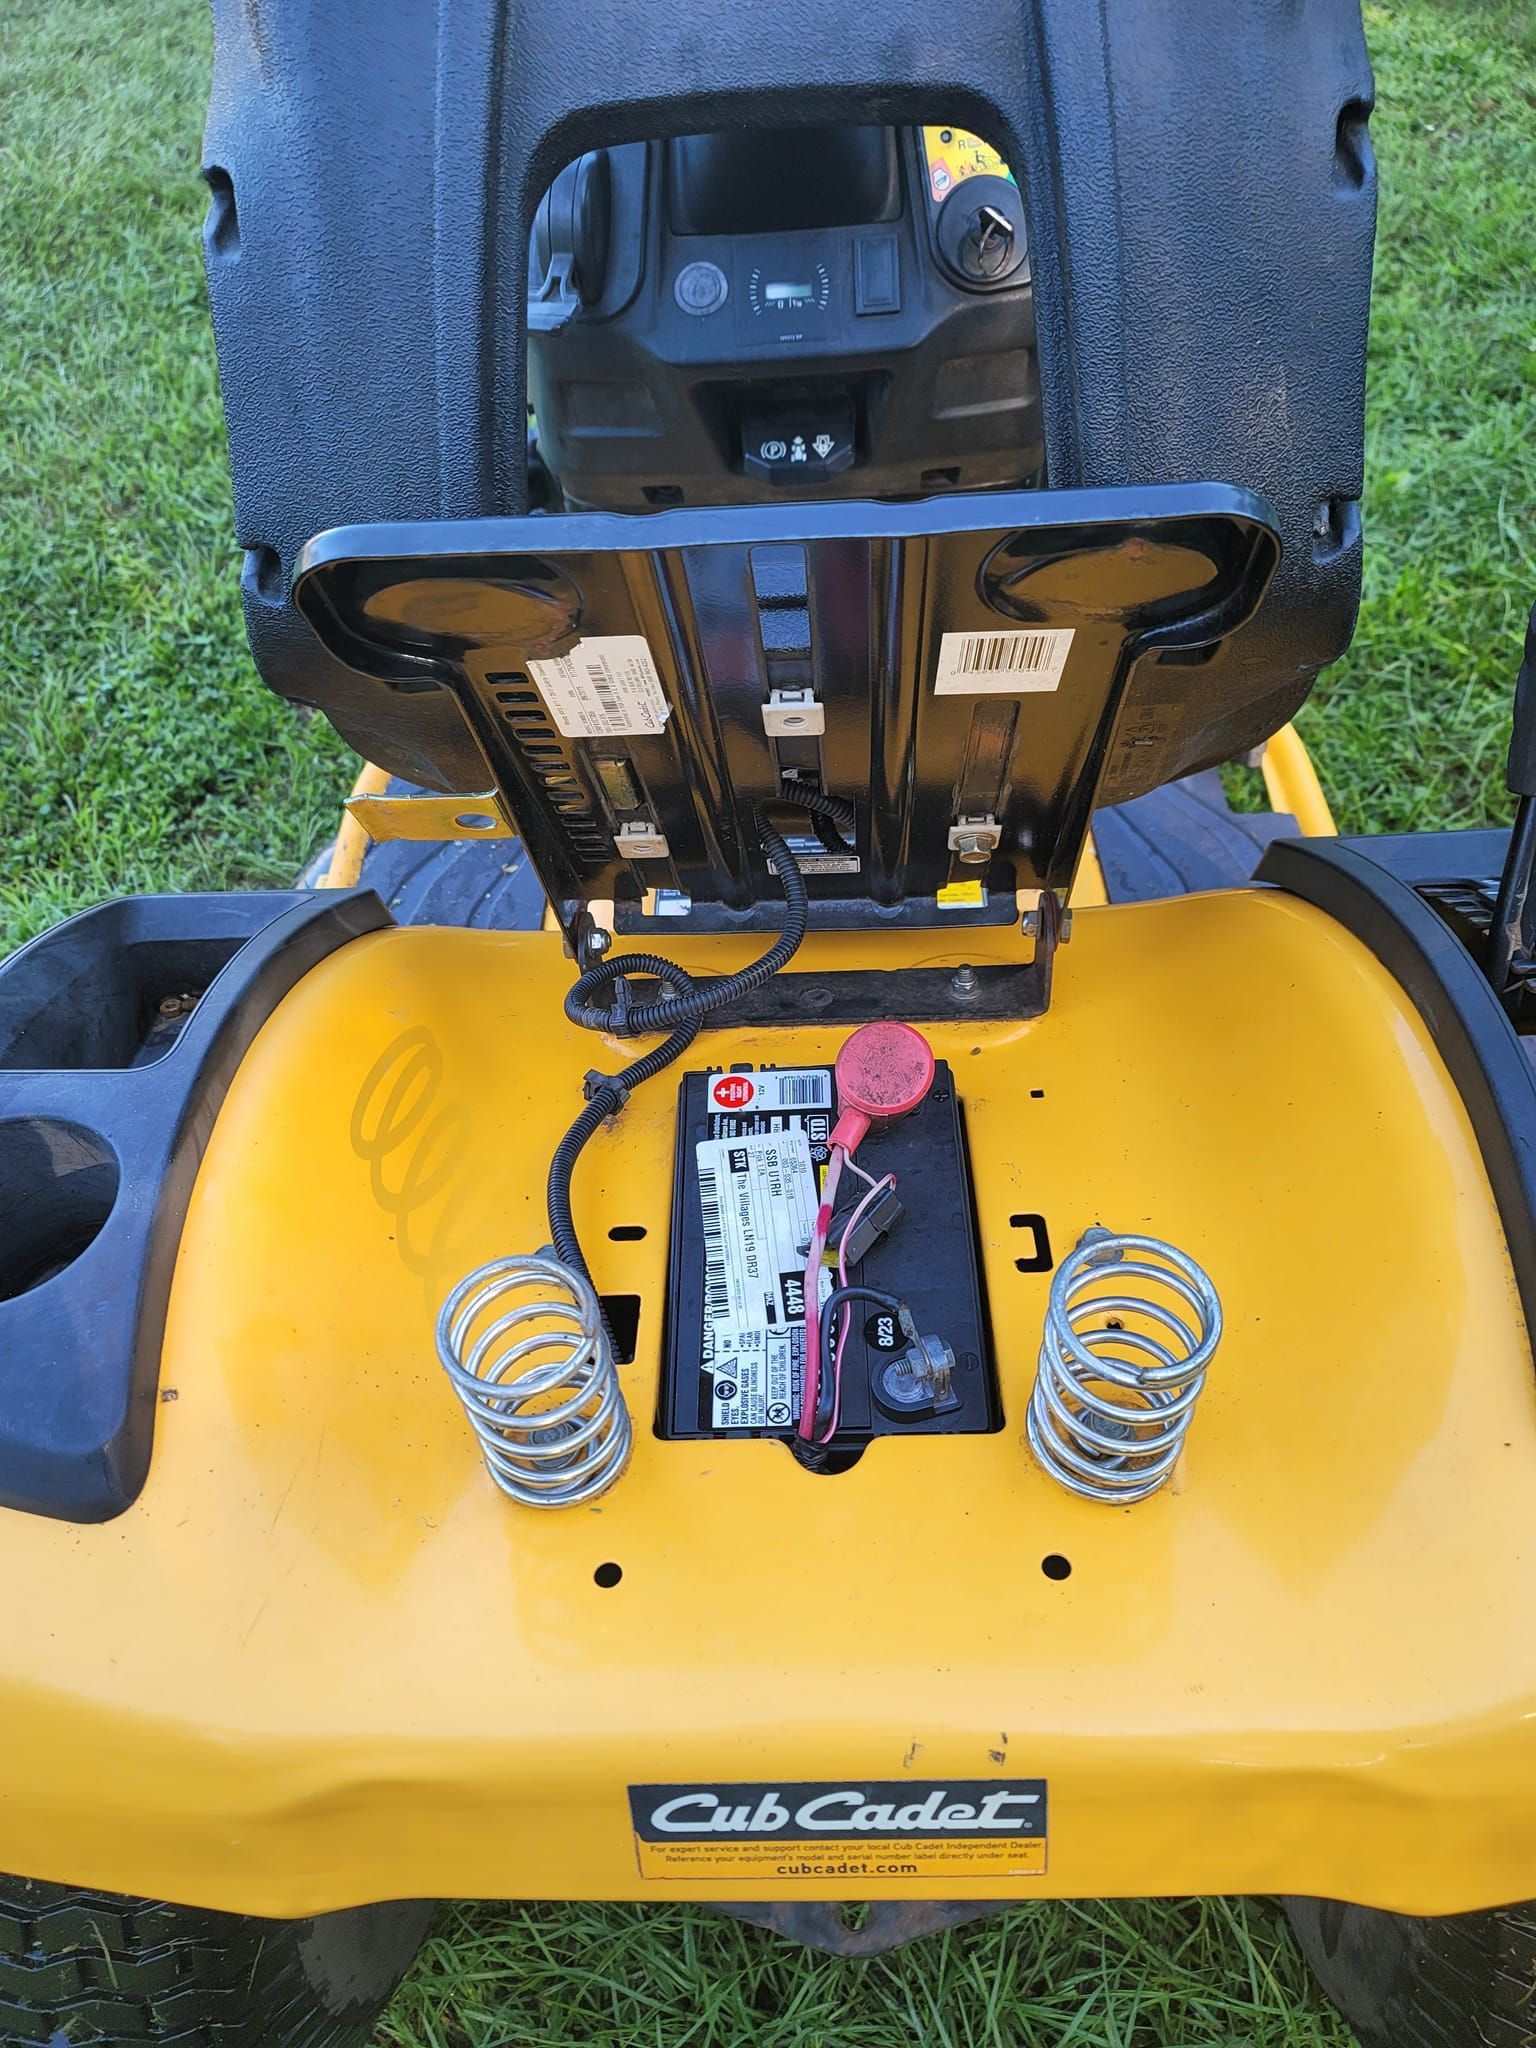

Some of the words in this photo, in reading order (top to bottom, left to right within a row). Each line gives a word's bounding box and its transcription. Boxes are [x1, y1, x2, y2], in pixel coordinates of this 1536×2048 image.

[811, 1118, 827, 1141] STD
[733, 1151, 747, 1169] STK
[765, 1149, 778, 1167] SSB
[736, 1174, 747, 1190] The
[768, 1170, 782, 1197] U1RH
[738, 1192, 751, 1227] Villages
[743, 1229, 756, 1252] LN19
[746, 1255, 759, 1279] DR37
[784, 1280, 805, 1314] 4448
[792, 1328, 800, 1356] EXPLOSION
[878, 1317, 894, 1347] 8/23
[723, 1340, 732, 1349] NO
[771, 1363, 778, 1371] OF
[778, 1344, 786, 1373] CHILDREN.
[741, 1368, 749, 1388] GASES
[750, 1362, 758, 1392] BLINDNESS
[792, 1380, 800, 1392] RISK
[778, 1382, 786, 1399] REACH
[740, 1390, 749, 1424] EXPLOSIVE
[750, 1393, 758, 1411] CAUSE
[758, 1392, 766, 1414] INJURY.
[792, 1394, 800, 1420] WARNING:
[721, 1403, 730, 1425] SHIELD
[731, 1406, 739, 1425] EYES.
[750, 1411, 758, 1424] CAN
[758, 1414, 765, 1424] OR
[650, 1793, 790, 1832] Cub
[795, 1791, 1040, 1830] Cadet
[650, 1845, 666, 1853] For
[670, 1845, 701, 1854] expert
[742, 1844, 760, 1852] and
[763, 1845, 800, 1853] support
[843, 1844, 864, 1852] your
[947, 1842, 1007, 1851] Independent
[1011, 1841, 1044, 1849] Dealer.
[739, 1854, 793, 1863] equipment's
[797, 1853, 824, 1861] model
[847, 1852, 872, 1860] serial
[875, 1852, 911, 1860] number
[914, 1852, 937, 1860] label
[939, 1852, 974, 1861] directly
[1008, 1851, 1029, 1859] seat.
[777, 1863, 917, 1875] cubcadet.com
